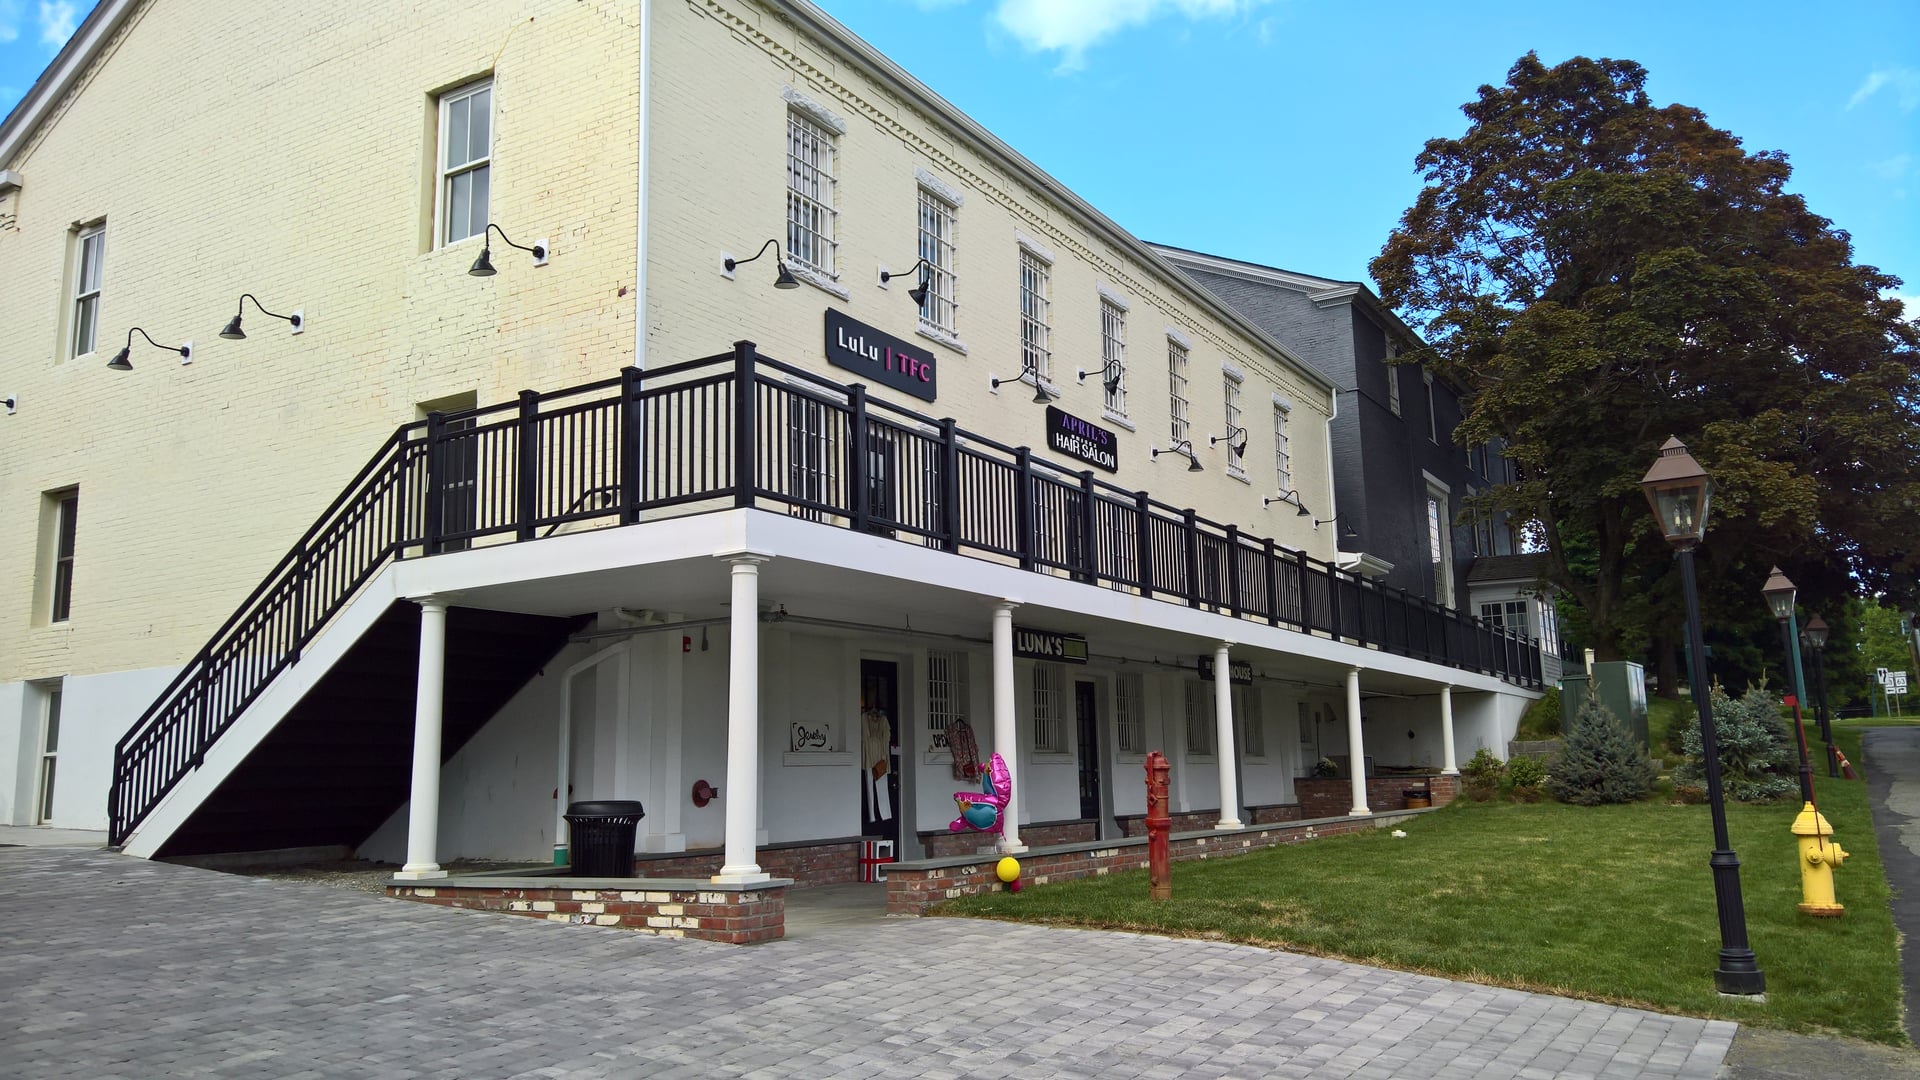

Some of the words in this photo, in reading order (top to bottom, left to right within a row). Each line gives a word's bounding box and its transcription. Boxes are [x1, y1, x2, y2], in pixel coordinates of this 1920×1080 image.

[838, 326, 878, 361] LuLu
[897, 352, 931, 382] TFC
[1062, 414, 1108, 445] APRIL'S
[1056, 432, 1080, 455] HAIR
[1082, 443, 1115, 468] SALON
[1017, 631, 1063, 656] LUNA'S
